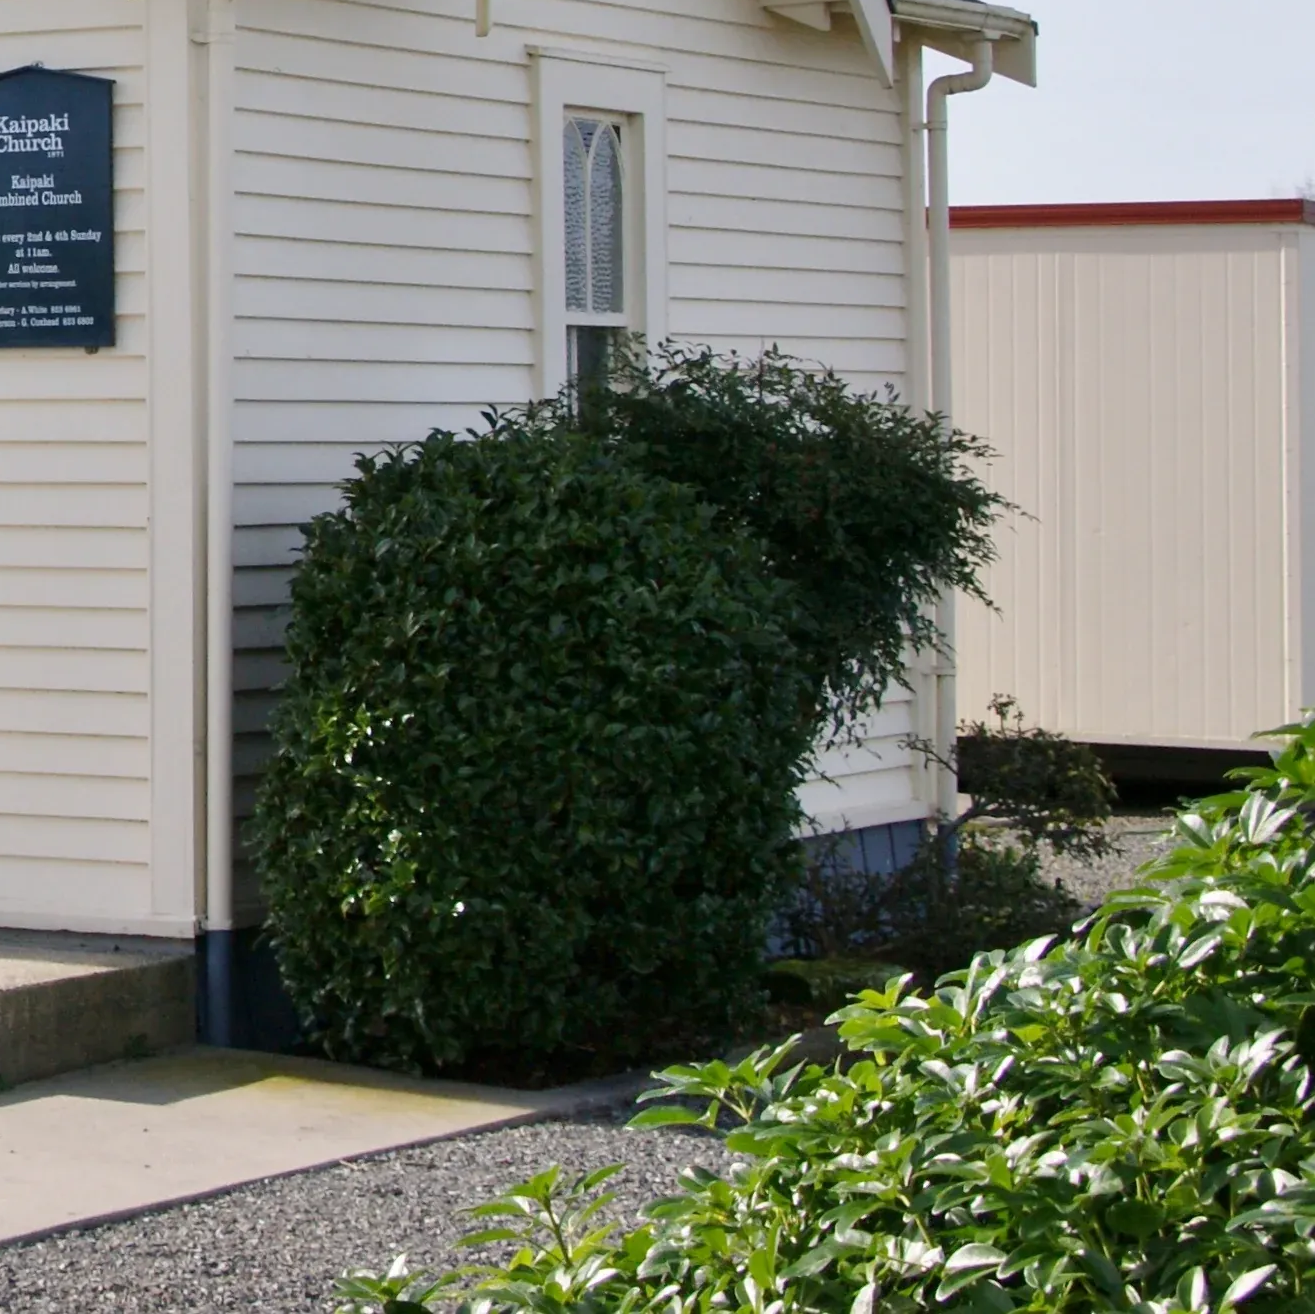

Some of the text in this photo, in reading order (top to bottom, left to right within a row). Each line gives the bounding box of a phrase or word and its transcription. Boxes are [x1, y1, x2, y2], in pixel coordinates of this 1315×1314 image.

[11, 174, 55, 192] Kaipaki
[41, 190, 82, 205] Church
[2, 233, 25, 245] every
[26, 231, 44, 242] 2nd
[44, 231, 53, 242] &
[54, 230, 69, 242] 4th
[70, 229, 102, 243] Sunday
[15, 248, 25, 258] at
[7, 263, 21, 275] All
[30, 280, 39, 289] by
